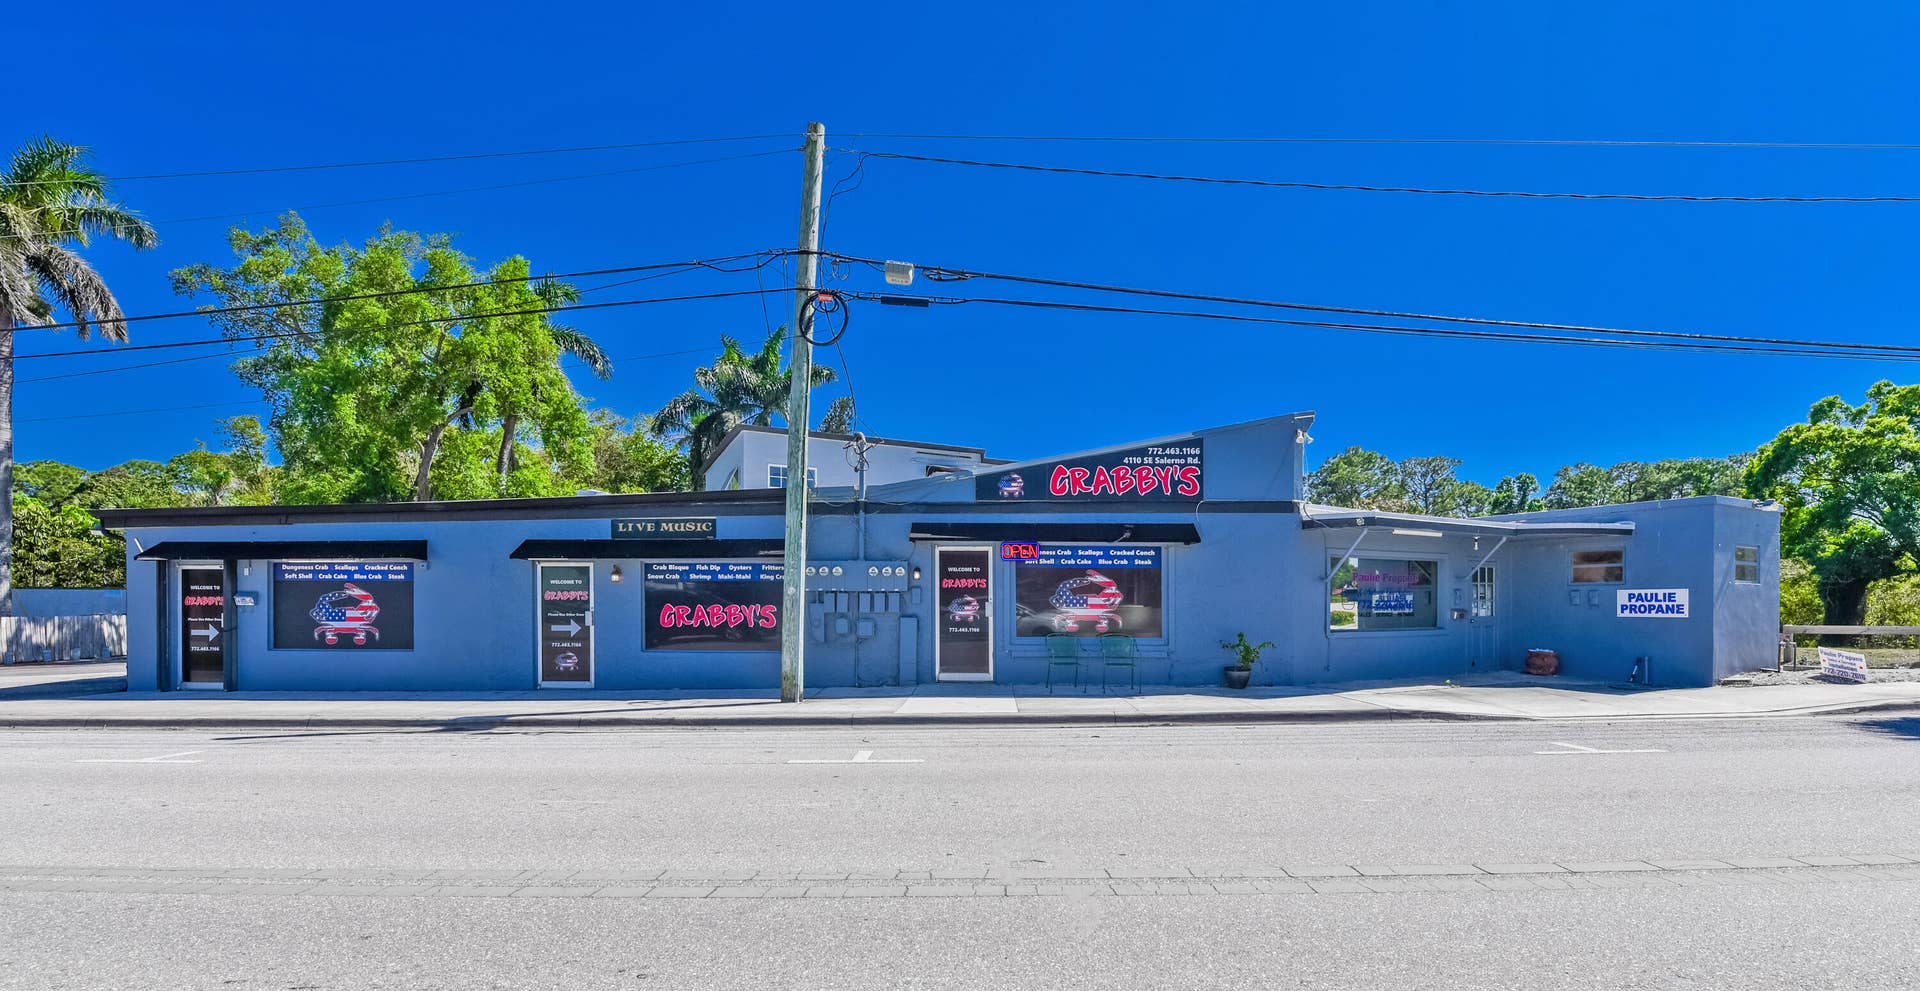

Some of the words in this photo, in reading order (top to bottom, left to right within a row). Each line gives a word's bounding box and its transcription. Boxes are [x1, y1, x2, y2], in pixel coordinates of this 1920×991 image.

[1050, 464, 1200, 496] CRABBY'S
[618, 522, 655, 532] LIVE
[660, 522, 712, 532] MUSIC
[1004, 544, 1038, 558] OPEN
[942, 578, 987, 588] CRABBY'S
[544, 591, 588, 600] CRABBY'S
[1628, 592, 1676, 602] PAULIE
[1620, 604, 1684, 614] PROPANE
[660, 603, 777, 628] CRABBY'S
